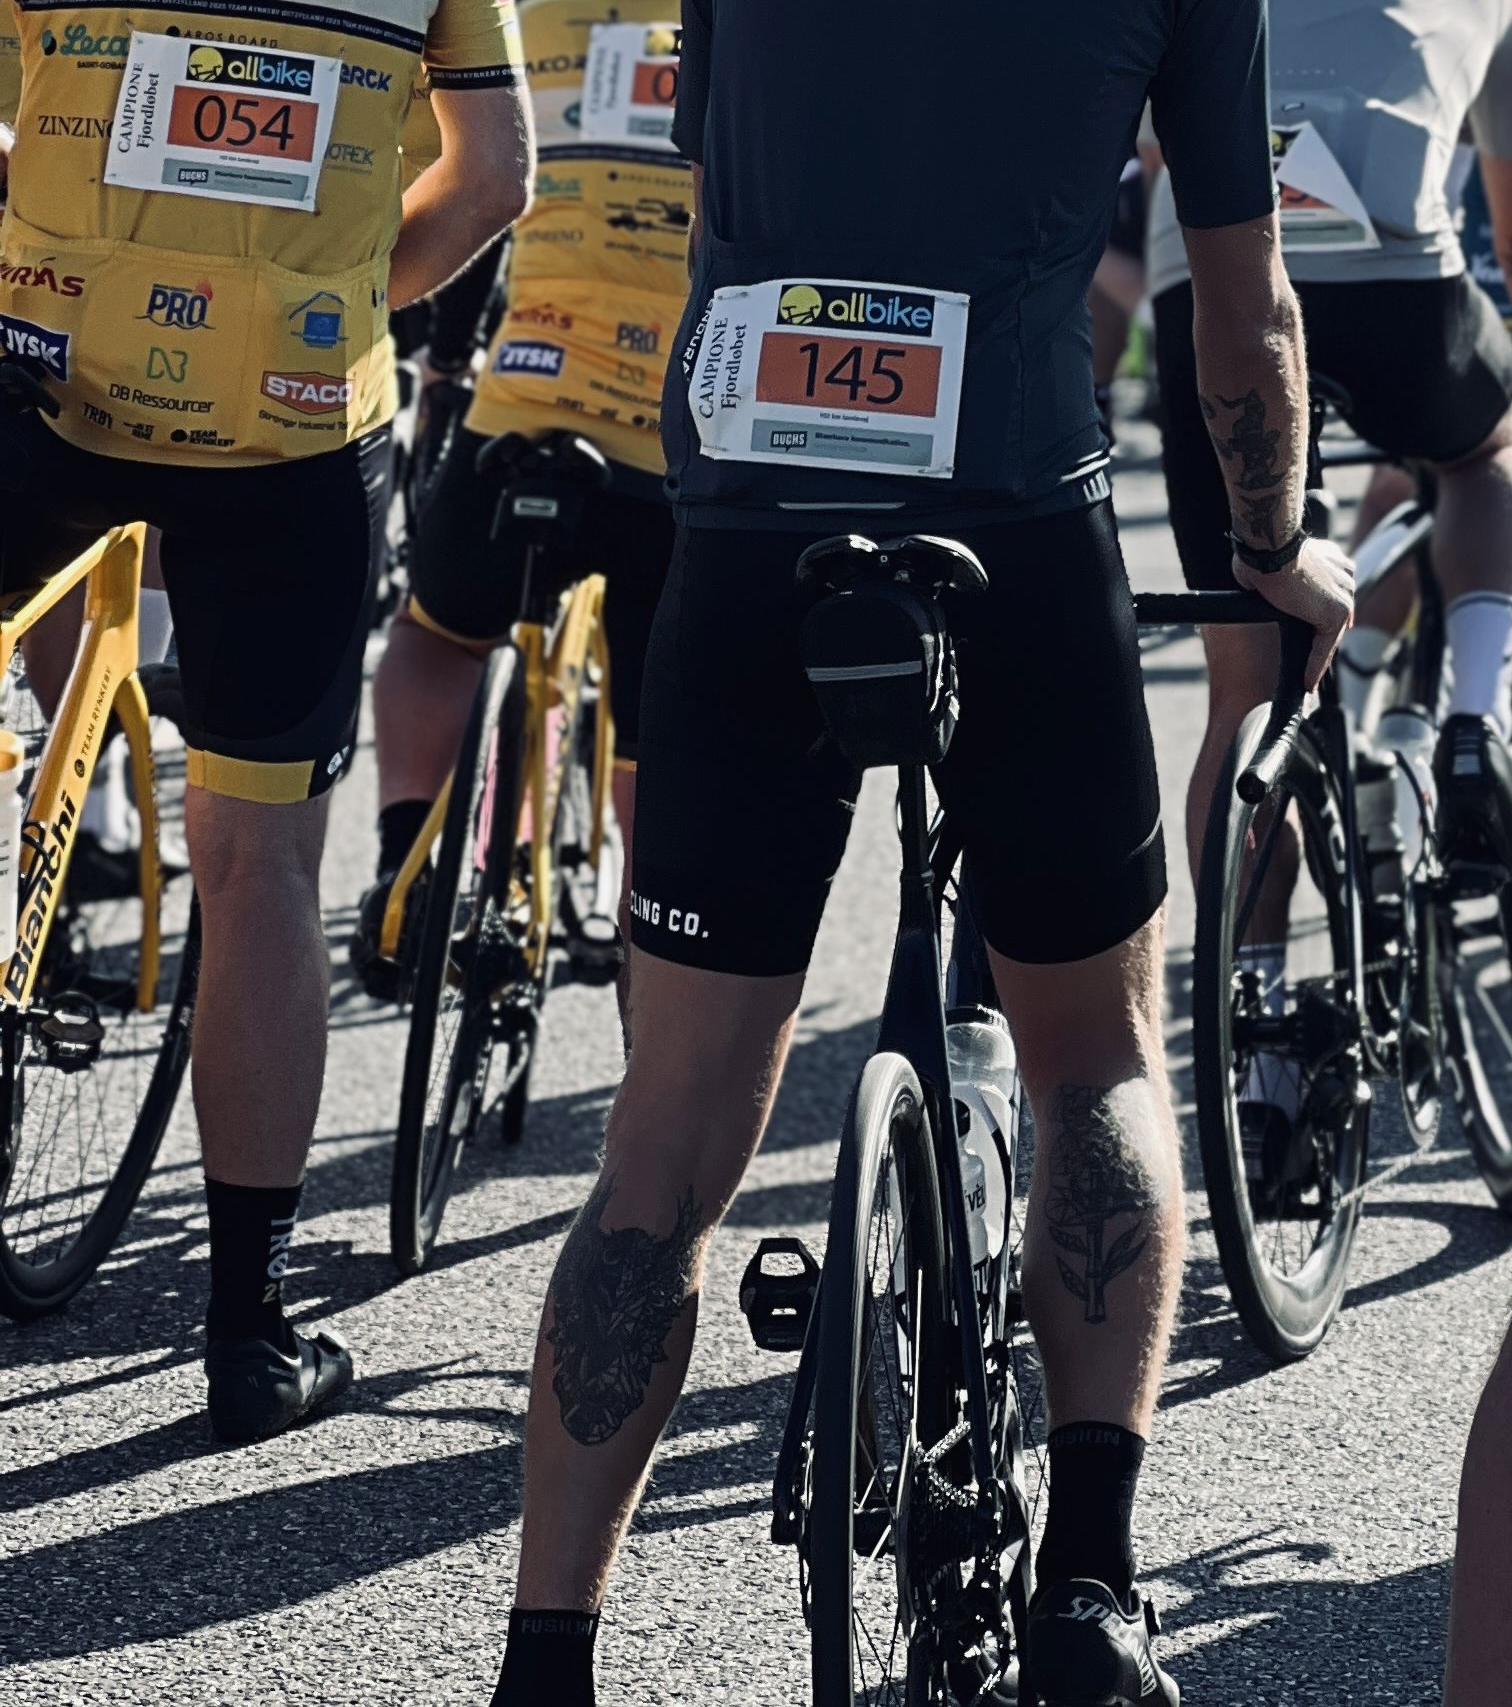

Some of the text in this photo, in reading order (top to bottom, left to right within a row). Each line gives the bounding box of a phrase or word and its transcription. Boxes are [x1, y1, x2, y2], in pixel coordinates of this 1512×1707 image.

[227, 51, 313, 88] allbike
[340, 63, 393, 92] ERCK
[117, 62, 145, 154] CAMPIONE
[136, 73, 160, 149] Fjordløbet
[192, 95, 295, 151] 054
[146, 288, 208, 327] PRO
[827, 292, 932, 329] allbike
[6, 327, 61, 369] JYSK
[616, 321, 659, 354] PRO
[503, 346, 560, 371] JYSK
[698, 316, 729, 419] CAMPIONE
[720, 323, 748, 410] Fjordløbet
[799, 341, 906, 405] 145
[109, 383, 215, 414] DB Ressourcer
[772, 432, 806, 446] BUCHS
[80, 664, 114, 756] TEAM RYNKEBY
[4, 789, 77, 1001] Bianchi
[667, 907, 710, 939] CO.
